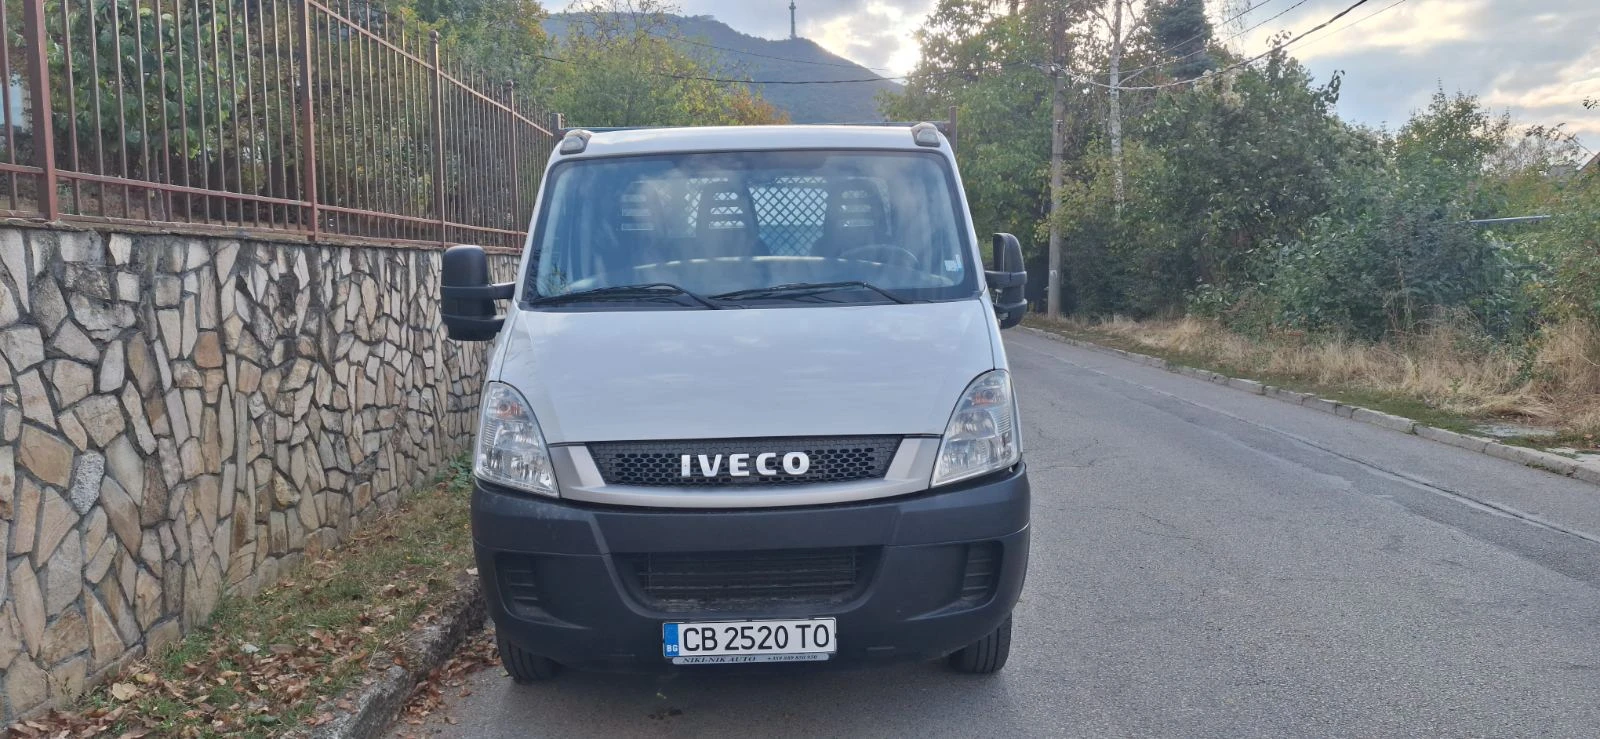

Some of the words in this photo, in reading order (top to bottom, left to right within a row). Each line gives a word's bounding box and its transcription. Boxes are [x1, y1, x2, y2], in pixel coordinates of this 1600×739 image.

[681, 451, 810, 477] IVECO
[666, 644, 680, 652] BG
[683, 627, 718, 652] CB
[724, 625, 789, 651] 2520
[795, 624, 830, 649] TO
